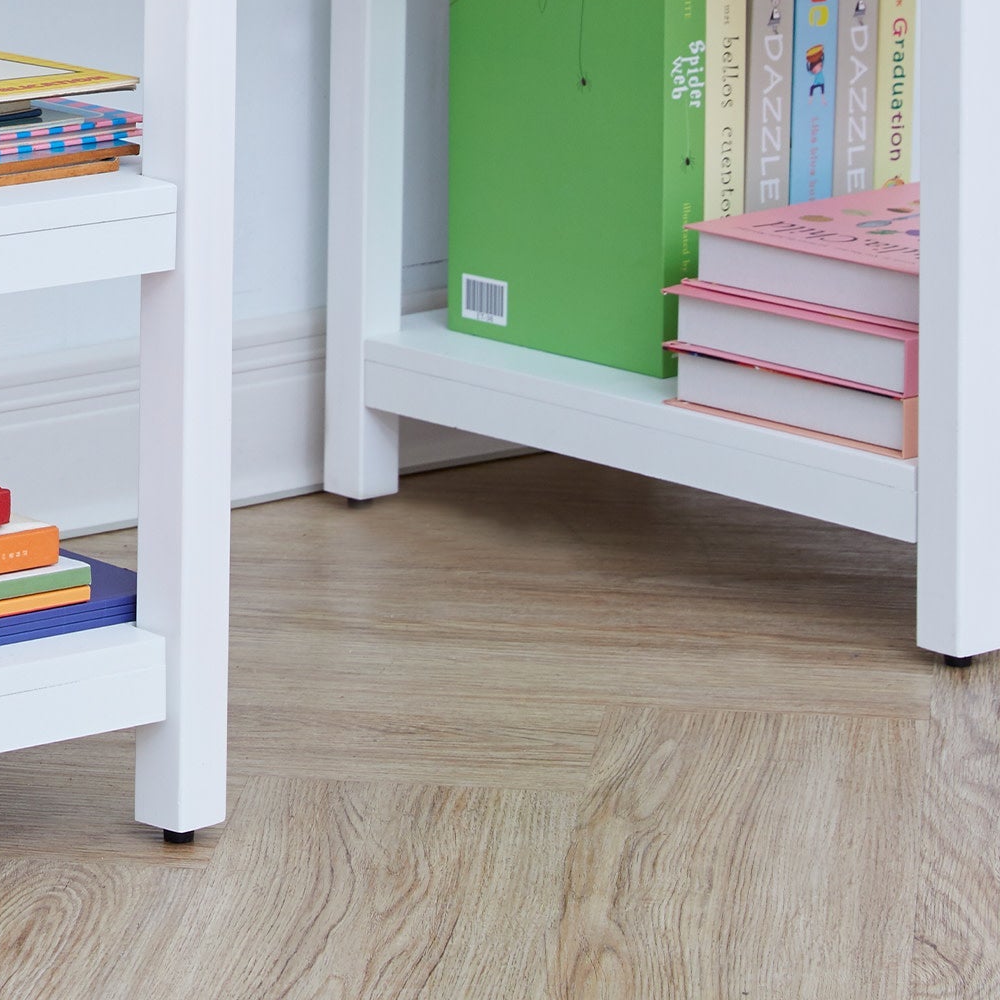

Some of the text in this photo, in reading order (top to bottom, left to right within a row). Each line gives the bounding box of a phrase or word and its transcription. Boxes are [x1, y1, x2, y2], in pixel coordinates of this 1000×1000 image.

[671, 55, 689, 100] web
[688, 39, 706, 108] Spider
[721, 36, 739, 109] bellos
[760, 34, 783, 203] DAZZLE
[847, 26, 869, 193] DAZZLE
[890, 17, 908, 161] Graduation
